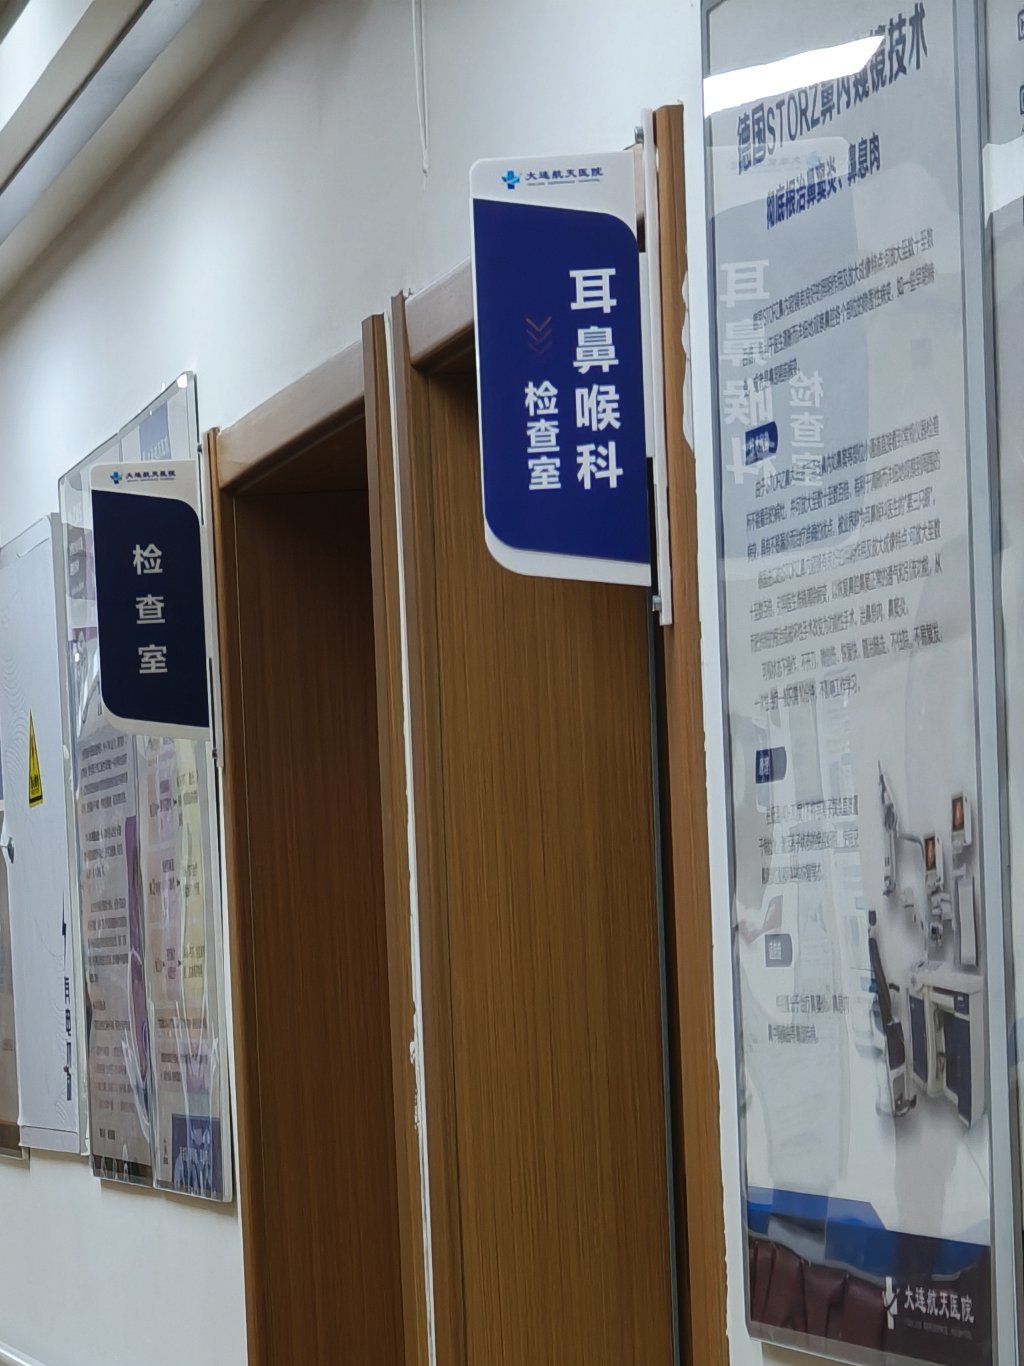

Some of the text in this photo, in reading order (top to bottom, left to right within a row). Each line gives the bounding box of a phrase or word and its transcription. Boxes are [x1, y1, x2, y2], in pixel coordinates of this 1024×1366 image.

[525, 381, 562, 491] 检查室
[569, 267, 623, 490] 耳鼻喉科
[132, 543, 168, 674] 检查室
[904, 1284, 975, 1324] 大连航天医院
